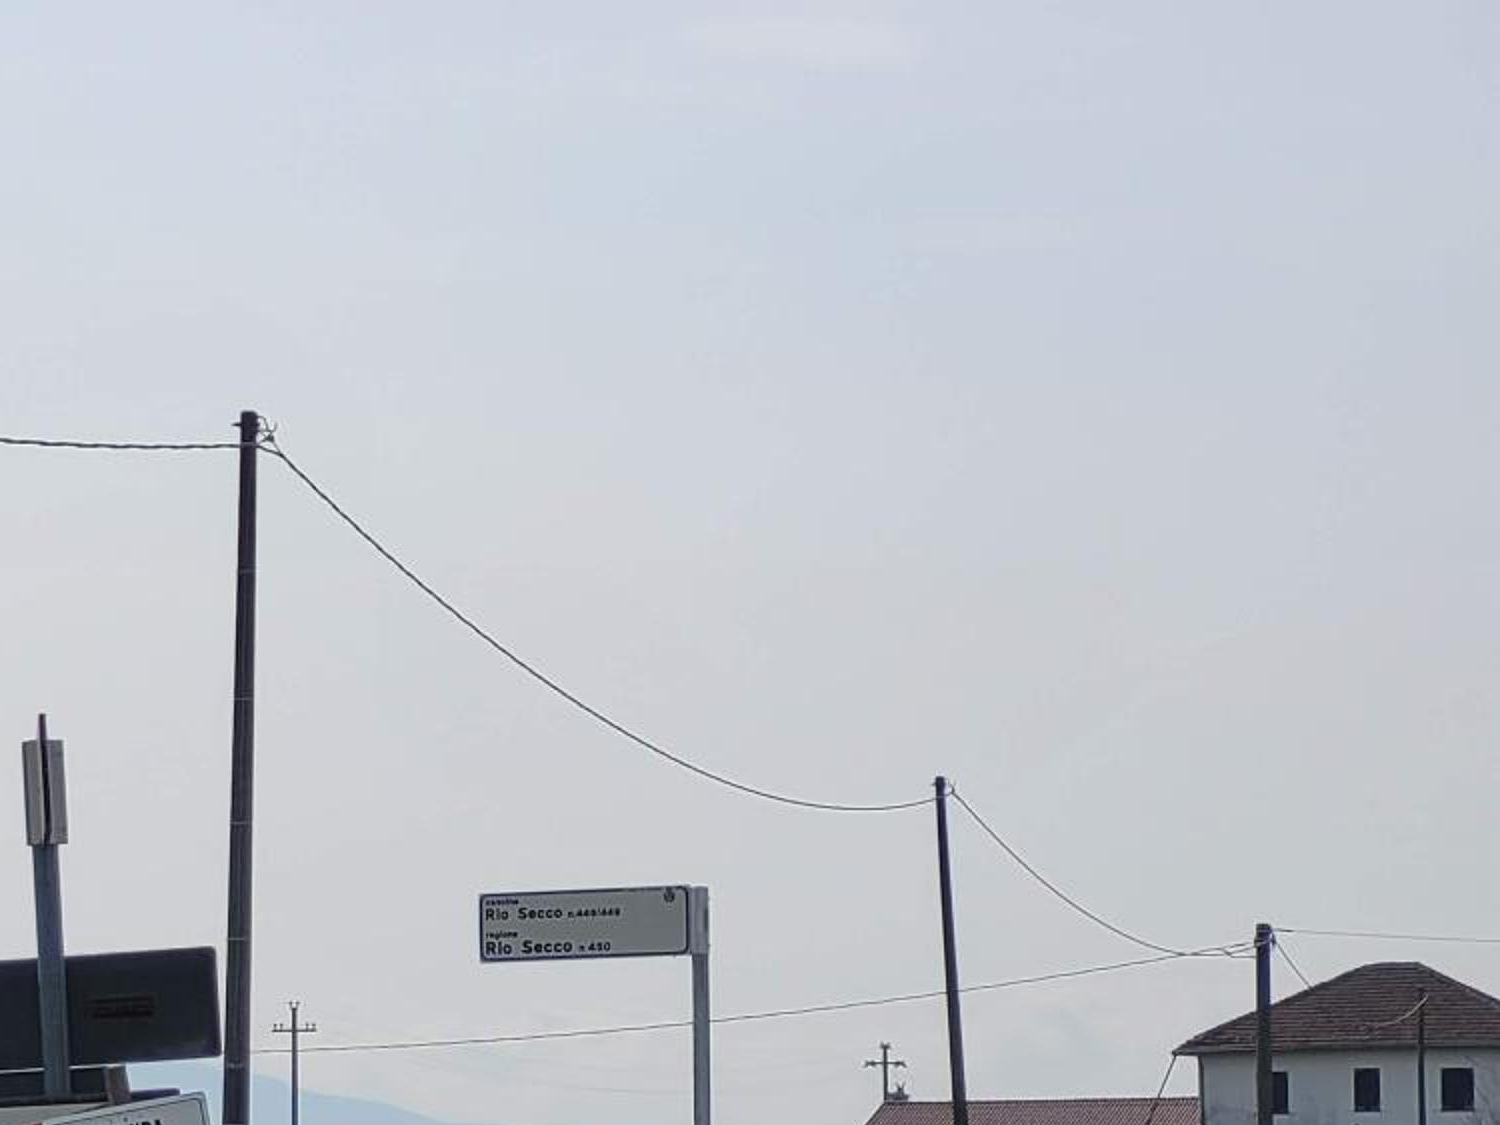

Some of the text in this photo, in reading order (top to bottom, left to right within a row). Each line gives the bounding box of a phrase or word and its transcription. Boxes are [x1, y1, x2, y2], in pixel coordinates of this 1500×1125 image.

[485, 908, 509, 920] Rio
[517, 907, 563, 919] Secco
[485, 941, 512, 955] Rio
[521, 940, 572, 953] Secco
